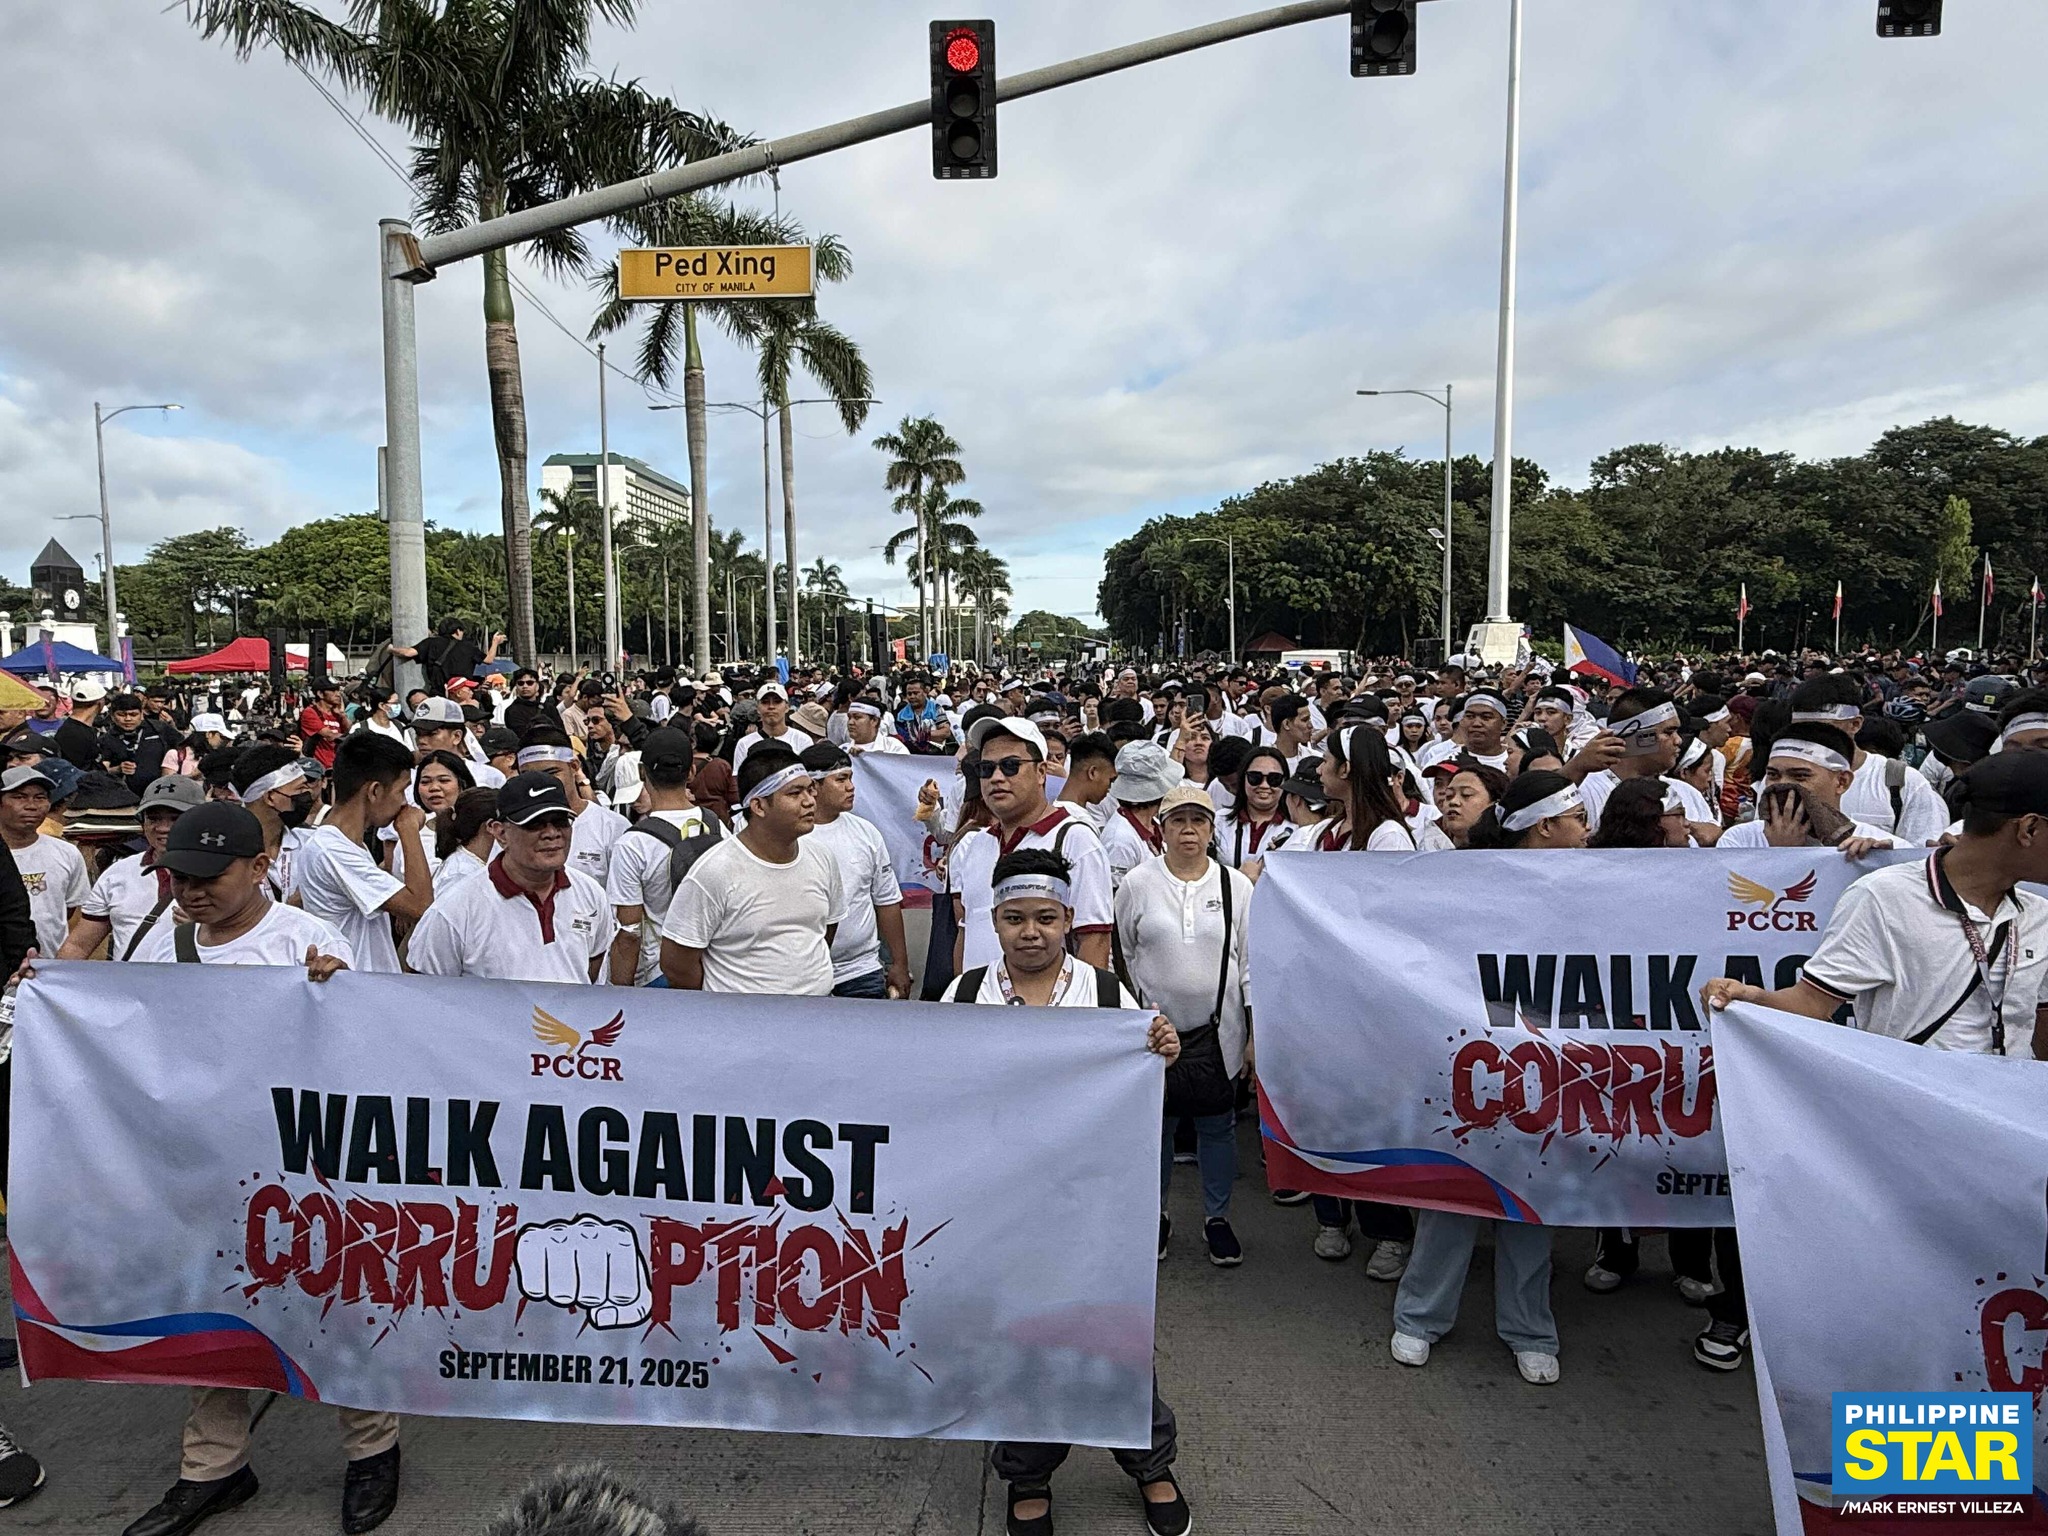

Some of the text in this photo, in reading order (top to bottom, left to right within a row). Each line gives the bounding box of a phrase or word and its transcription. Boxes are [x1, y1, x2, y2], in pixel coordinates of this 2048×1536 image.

[655, 251, 776, 282] Ped Xing
[675, 281, 756, 293] CITY OF MANILA
[1726, 911, 1818, 932] PCCR
[1477, 954, 1702, 1031] WALK
[531, 1053, 624, 1081] PCCR
[270, 1087, 890, 1214] WALK AGAINST
[439, 1350, 710, 1390] SEPTEMBER 21, 2025
